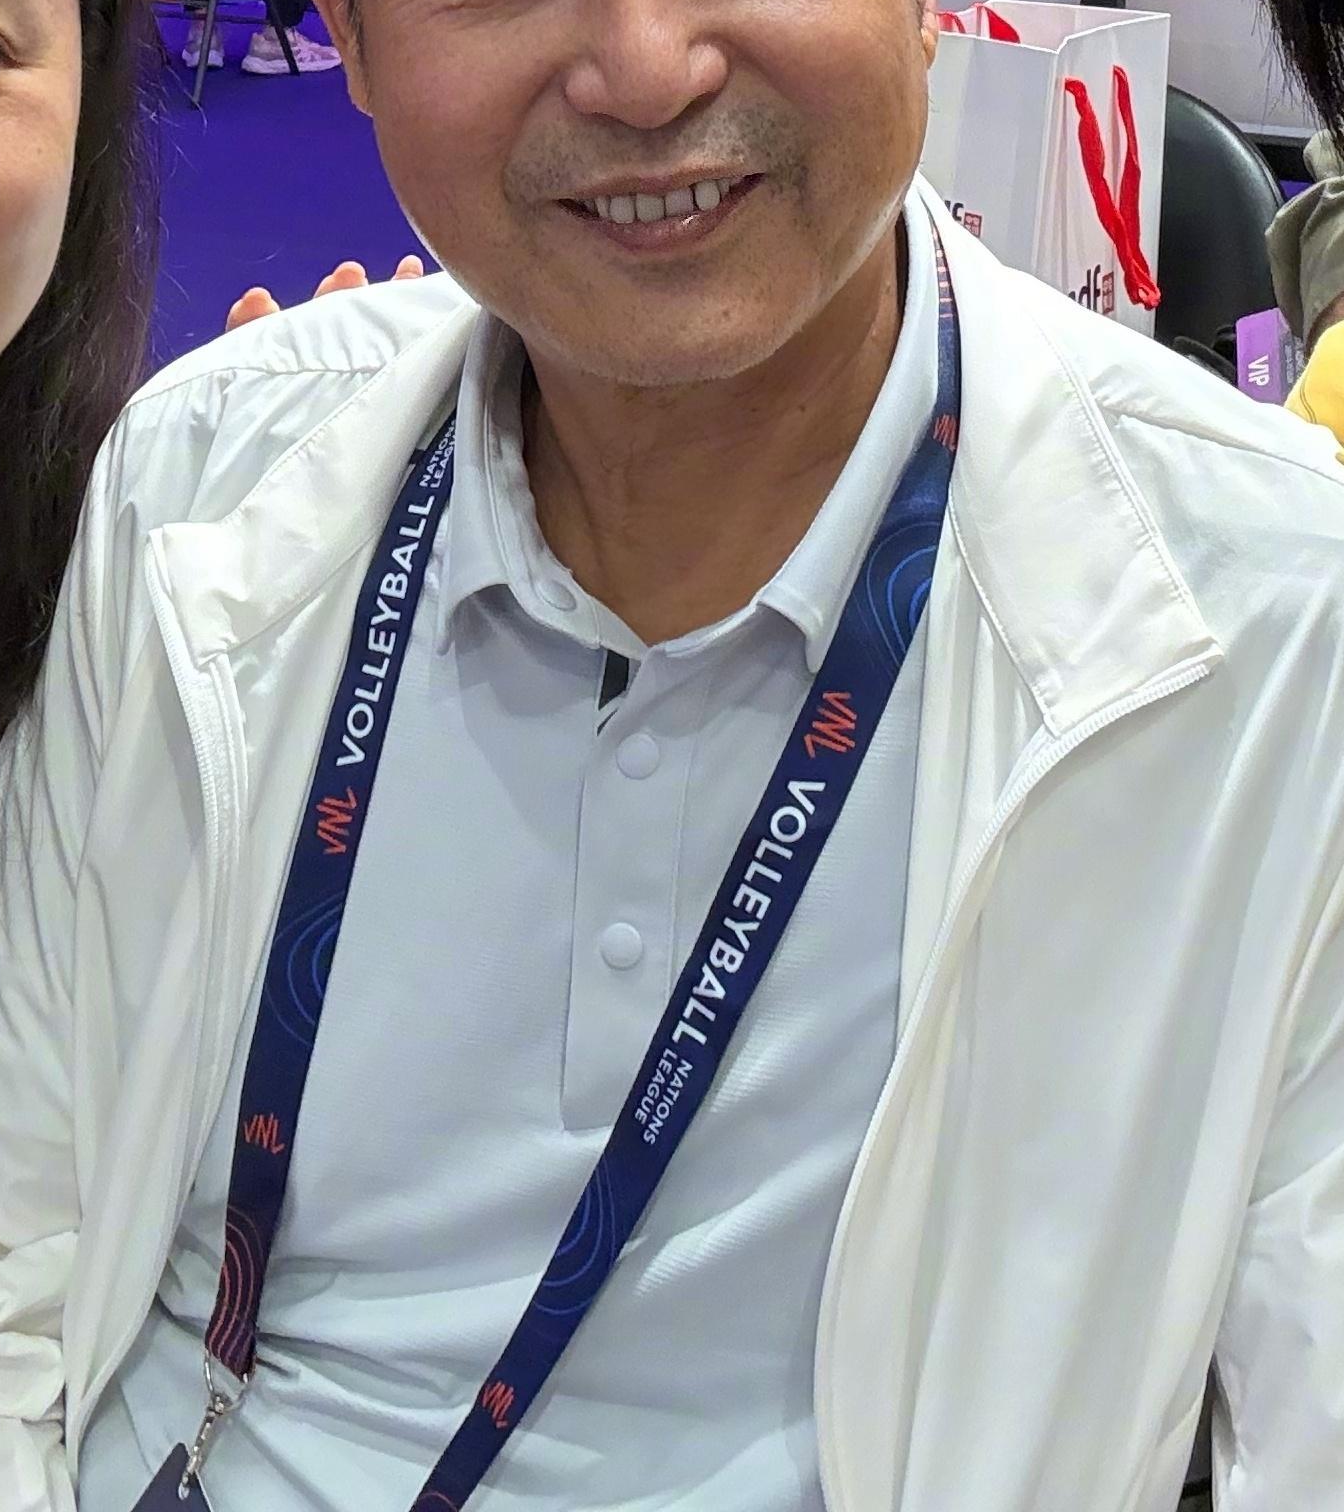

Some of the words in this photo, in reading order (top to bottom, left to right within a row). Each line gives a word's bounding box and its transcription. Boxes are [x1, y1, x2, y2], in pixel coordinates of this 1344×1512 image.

[1247, 354, 1271, 386] VIP
[430, 434, 457, 488] LEAG
[336, 494, 436, 768] VOLLEYBALL
[671, 780, 827, 1047] VOLLEYBALL
[633, 1049, 679, 1125] LEAGUE
[643, 1058, 695, 1146] NATIONS
